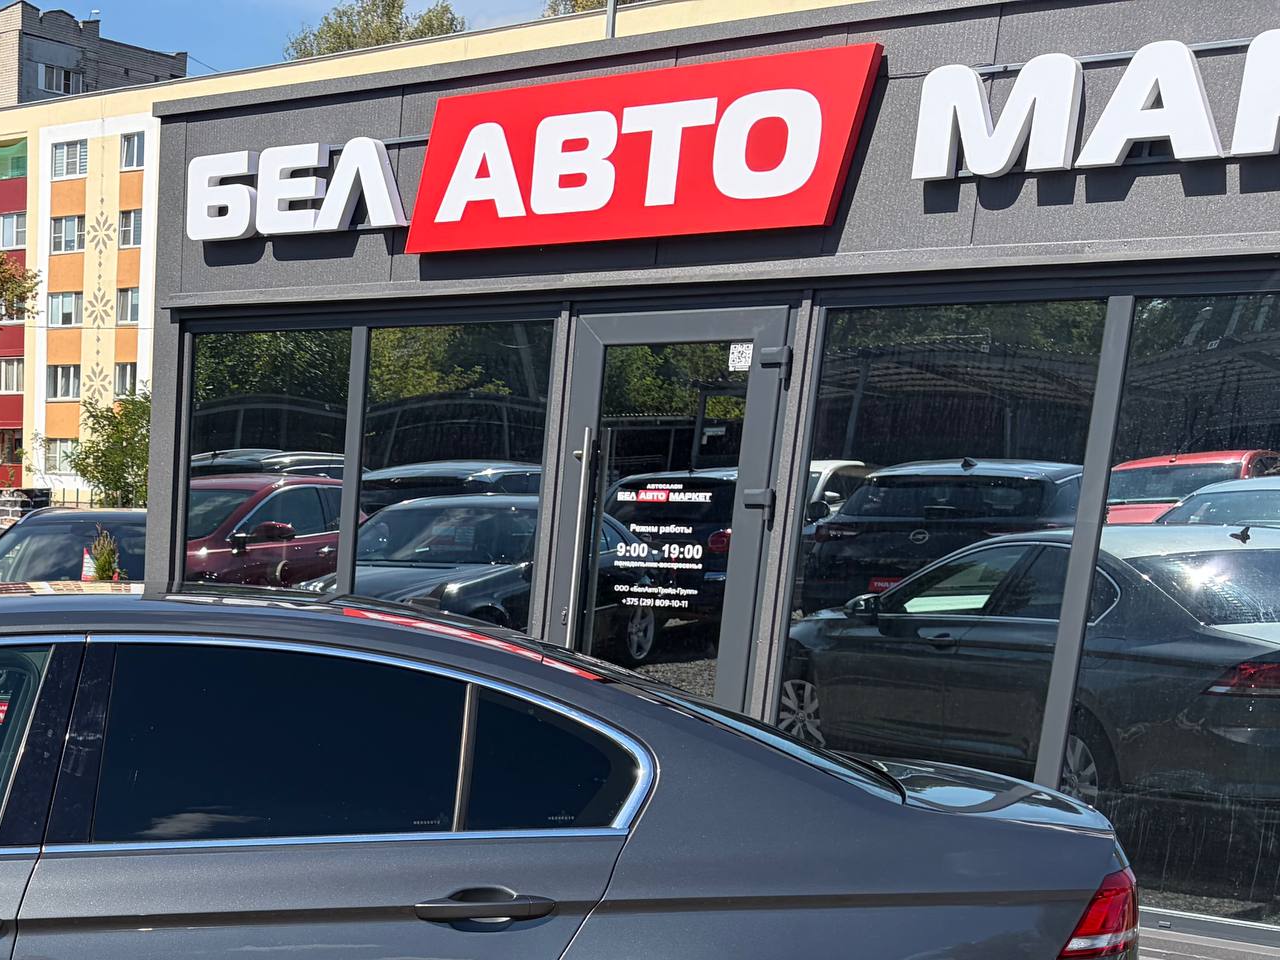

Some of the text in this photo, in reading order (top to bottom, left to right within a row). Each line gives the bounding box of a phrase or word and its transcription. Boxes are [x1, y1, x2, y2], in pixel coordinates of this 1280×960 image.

[186, 136, 409, 241] БЕЛ
[433, 88, 821, 223] АВТО
[617, 491, 712, 502] БЕЛ АВТО МАРКЕТ
[629, 523, 693, 534] Режим работы
[616, 542, 648, 557] 9:00
[661, 543, 703, 559] 19:00
[613, 584, 630, 592] ООО
[639, 598, 654, 607] (29)
[654, 599, 689, 608] 809-10-11
